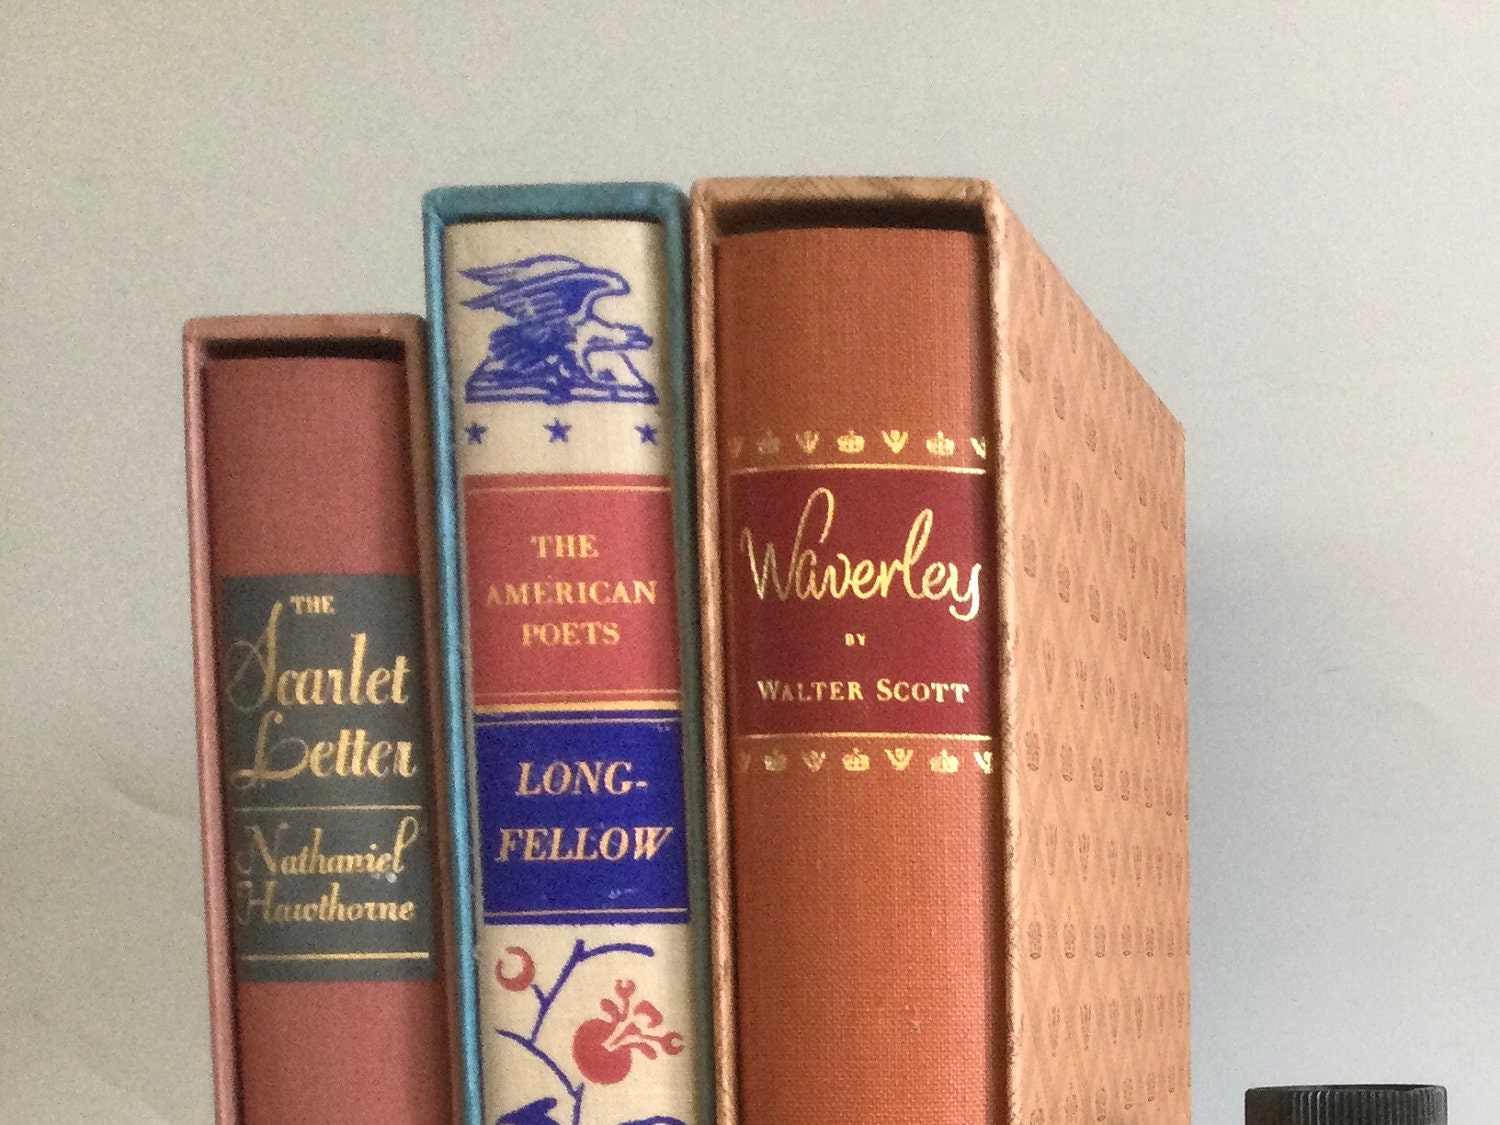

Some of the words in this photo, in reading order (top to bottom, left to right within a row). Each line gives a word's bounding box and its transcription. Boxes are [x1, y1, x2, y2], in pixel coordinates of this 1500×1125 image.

[531, 534, 599, 559] THE
[740, 487, 983, 622] Waverley
[290, 595, 336, 614] THE
[486, 580, 658, 606] AMERICAN
[521, 621, 621, 647] POETS
[844, 633, 867, 647] BY
[225, 601, 412, 712] Scarlet
[756, 679, 864, 702] WALTER
[876, 678, 970, 703] SCOTT
[230, 710, 417, 791] Letter
[515, 760, 649, 796] LONG-
[236, 815, 420, 876] Nathaniel
[495, 825, 674, 863] FELLOW
[236, 879, 415, 926] Hawthorne
